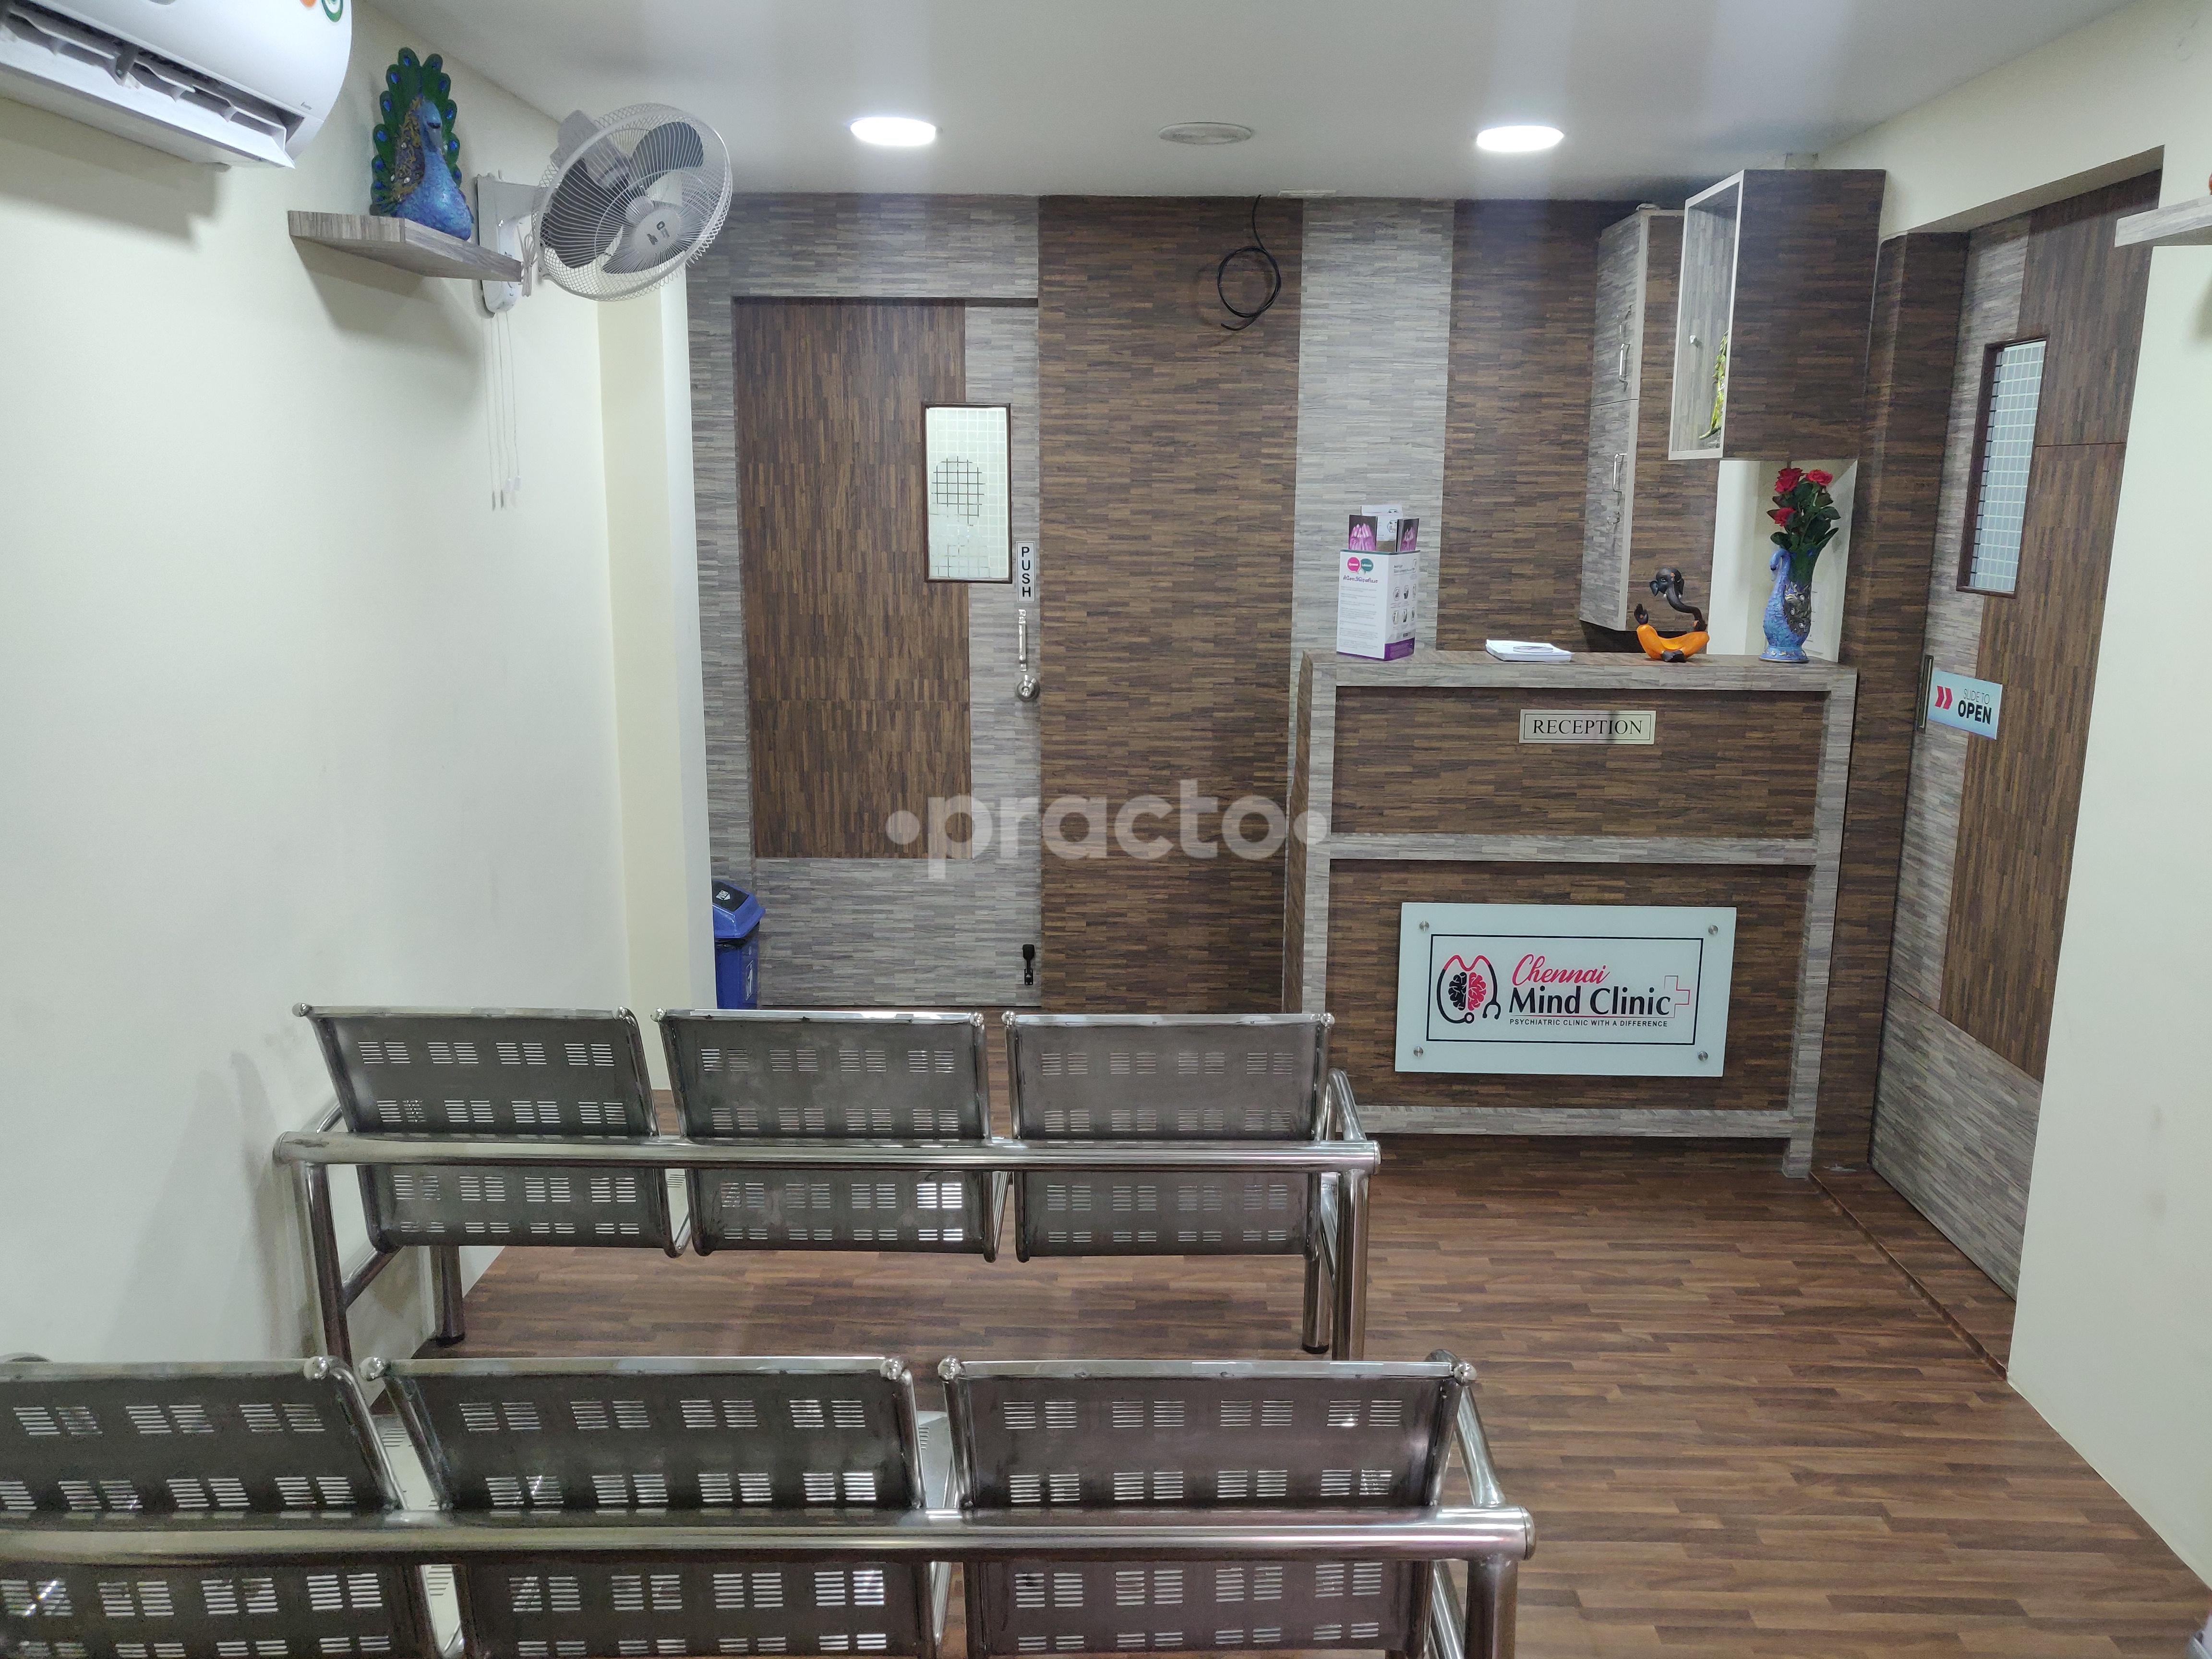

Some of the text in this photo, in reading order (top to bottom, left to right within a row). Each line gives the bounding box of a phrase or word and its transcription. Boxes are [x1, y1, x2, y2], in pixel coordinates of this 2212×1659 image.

[1022, 546, 1031, 598] PUSH
[1963, 688, 1990, 705] SLIDE TO
[1958, 700, 1992, 725] OPEN
[1532, 720, 1643, 734] RECEPTION
[1512, 954, 1610, 986] Chennai
[1509, 986, 1671, 1015] Mind Clinic
